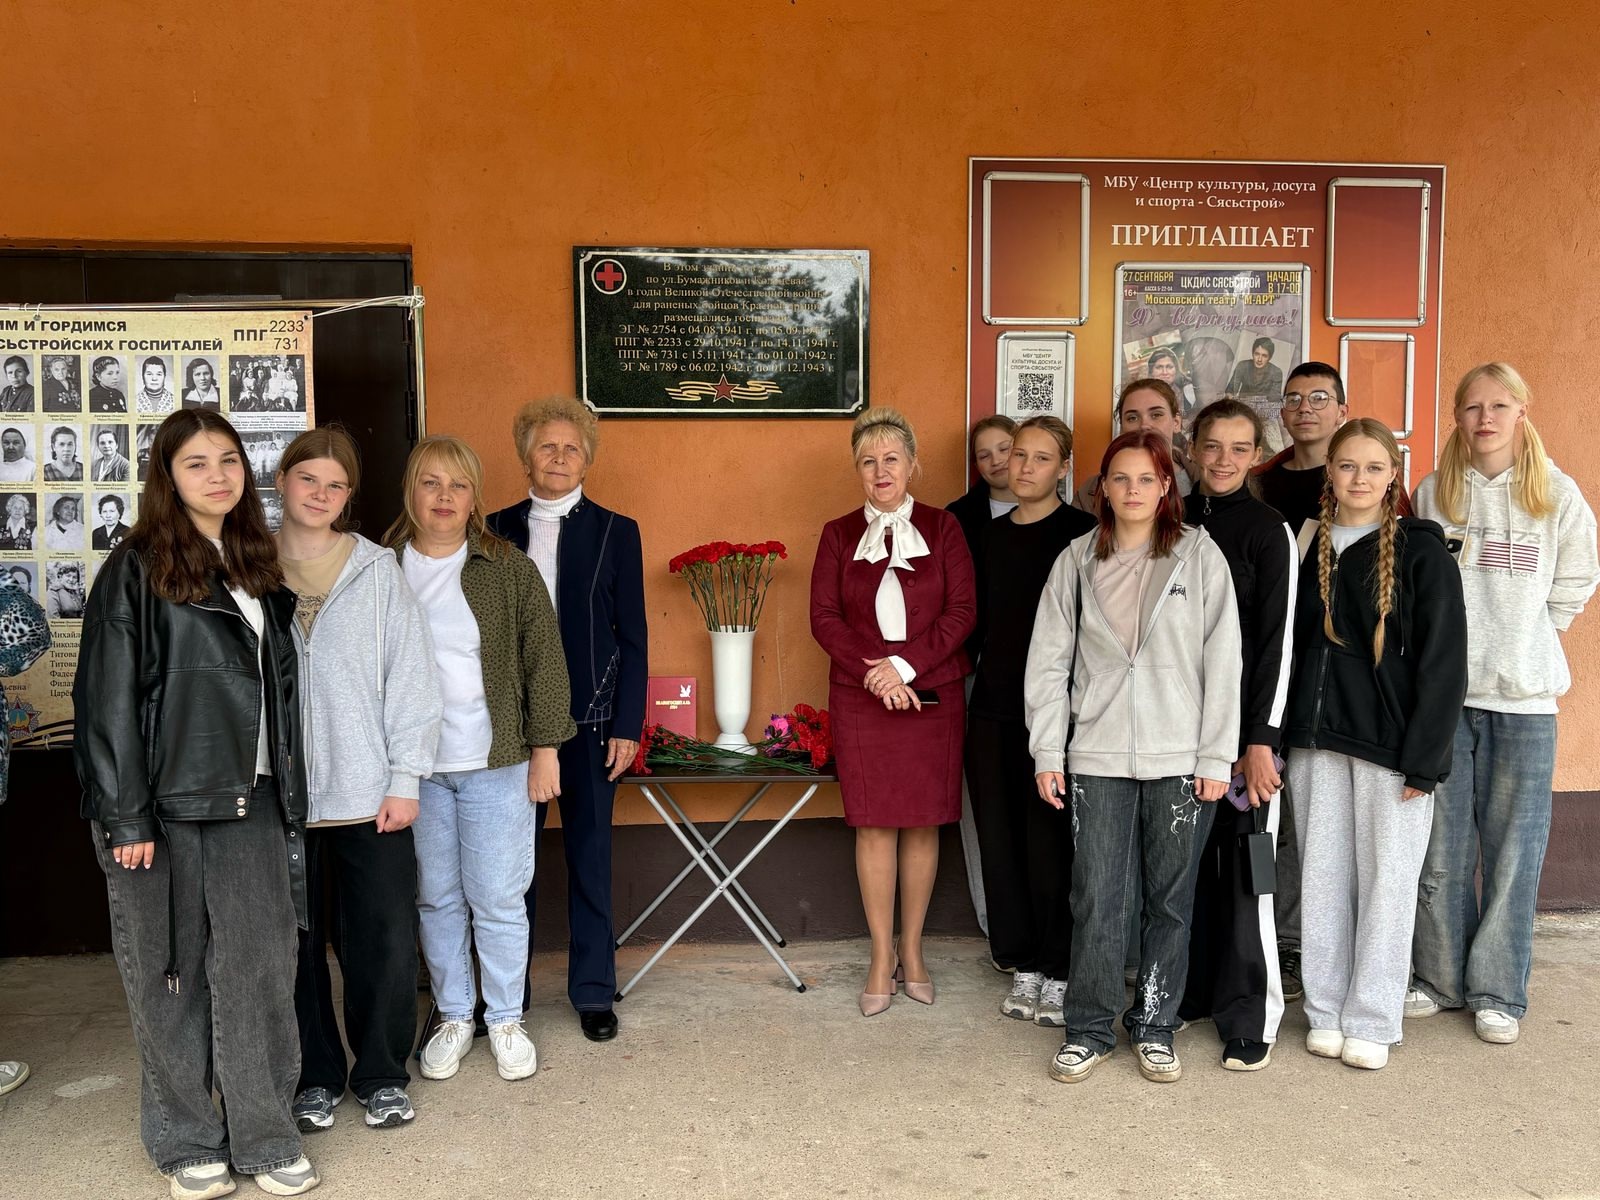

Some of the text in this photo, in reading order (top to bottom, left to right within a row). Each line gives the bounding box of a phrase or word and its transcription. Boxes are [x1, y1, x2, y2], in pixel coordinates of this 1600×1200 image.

[1104, 175, 1316, 194] МБУ «Центр культуры, досуга
[1135, 197, 1144, 206] и
[1148, 197, 1194, 210] спорта
[1206, 195, 1285, 211] Сясьстрой»
[1110, 224, 1314, 248] ПРИГЛАШАЕТ
[646, 276, 659, 284] по
[1123, 271, 1174, 282] 27 СЕНТЯБРЯ
[1180, 275, 1261, 289] ЦКДИС СЯСЬСТРОЙ
[1266, 271, 1301, 282] НАЧАЛО
[636, 289, 661, 298] годы
[664, 286, 709, 297] Великой
[1124, 288, 1137, 297] 16+
[1268, 282, 1301, 294] В 17-00
[1144, 293, 1205, 305] Московский
[1208, 295, 1237, 307] театр
[633, 302, 651, 310] для
[654, 302, 698, 311] раненых
[663, 315, 732, 324] размещались
[24, 320, 35, 331] И
[41, 320, 127, 334] ГОРДИМСЯ
[269, 320, 304, 333] 2233
[619, 324, 635, 334] ЭГ
[638, 324, 650, 334] №
[652, 324, 677, 335] 2754
[688, 325, 742, 335] 04.08.1941
[755, 327, 768, 335] по
[233, 329, 268, 341] ППГ
[119, 337, 223, 351] ГОСПИТАЛЕЙ
[273, 337, 298, 350] 731
[615, 337, 640, 347] ППГ
[643, 337, 655, 347] №
[657, 337, 682, 347] 2233
[693, 337, 747, 348] 29.10.1941
[761, 340, 774, 348] по
[777, 337, 828, 348] 14.11.1941
[618, 350, 644, 360] ППГ
[647, 350, 658, 360] №
[661, 350, 678, 360] 731
[692, 350, 744, 360] 15.11.1941
[757, 352, 770, 360] по
[772, 350, 826, 360] 01.01.1942
[829, 352, 836, 360] г.
[619, 362, 636, 372] ЭГ
[638, 362, 650, 372] №
[653, 362, 678, 372] 1789
[688, 362, 743, 373] 06.02.1942
[756, 364, 769, 373] по
[771, 362, 825, 373] 01.12.1943
[49, 650, 77, 658] Титова
[49, 660, 77, 668] Титова
